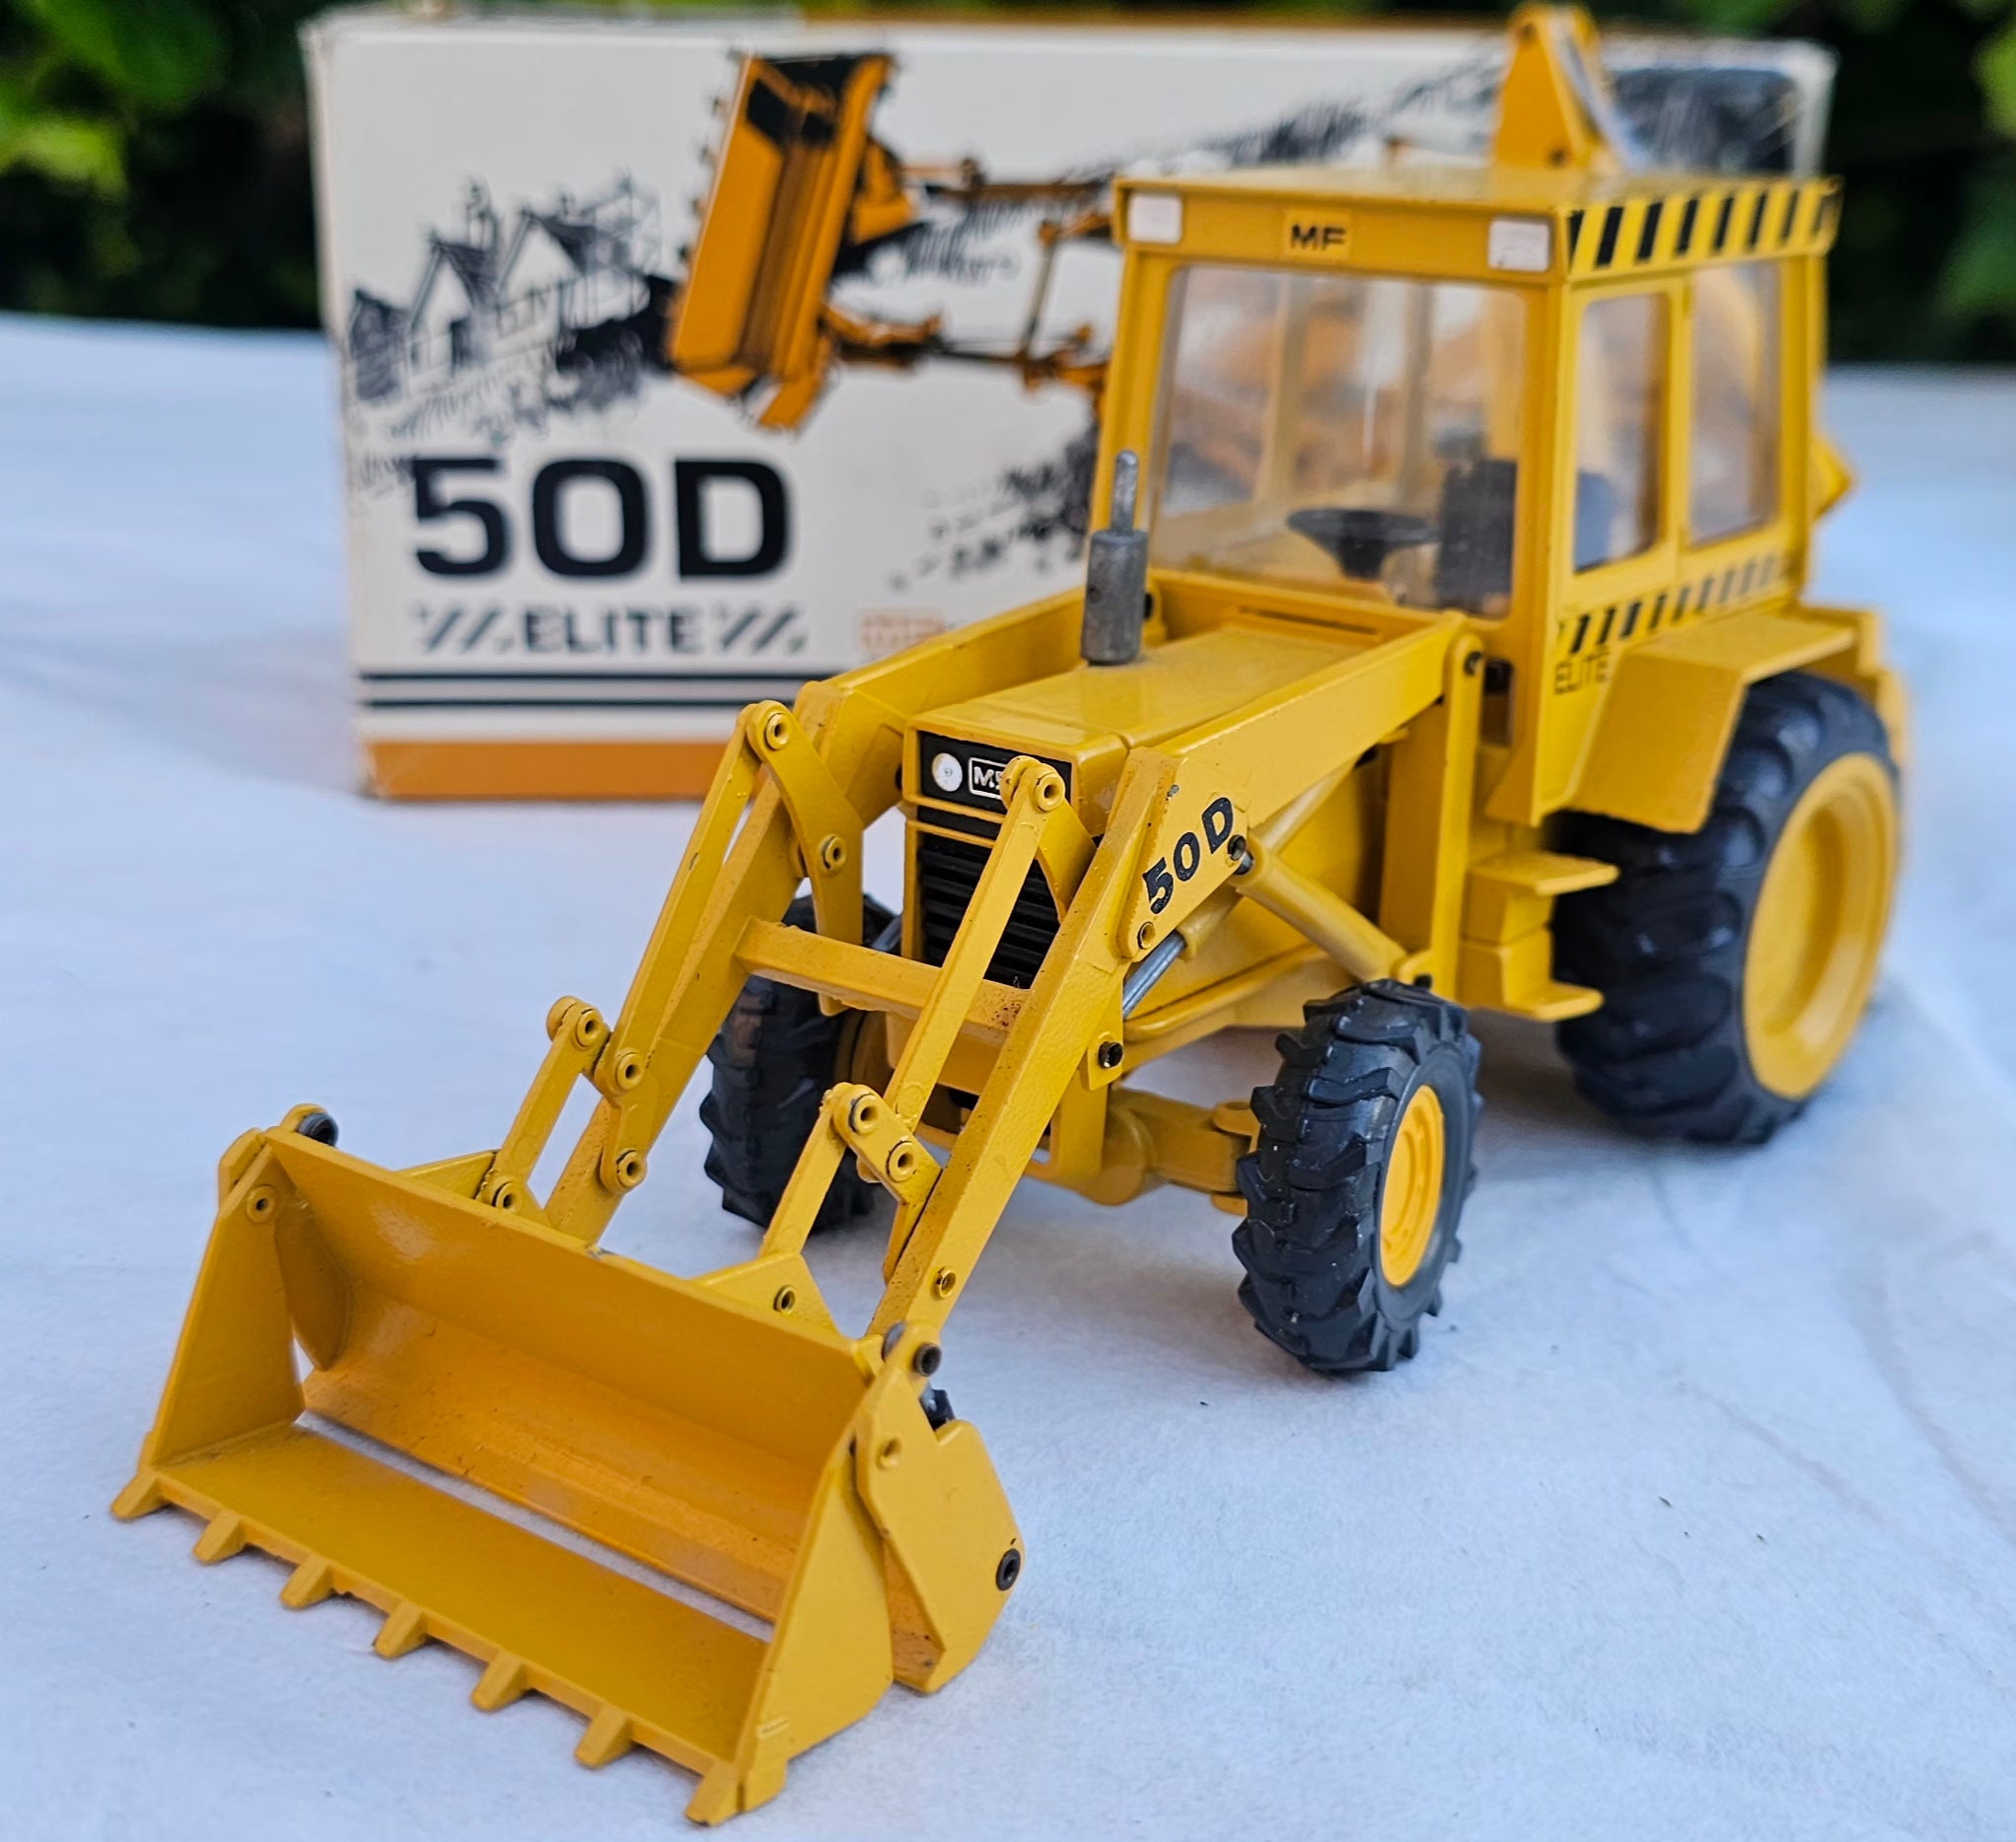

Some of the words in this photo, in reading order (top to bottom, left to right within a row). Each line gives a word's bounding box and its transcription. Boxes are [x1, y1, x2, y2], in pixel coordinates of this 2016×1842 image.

[1290, 223, 1346, 250] MF
[412, 457, 790, 580] 50D
[520, 602, 704, 654] ELITE
[1553, 643, 1611, 695] ELITE
